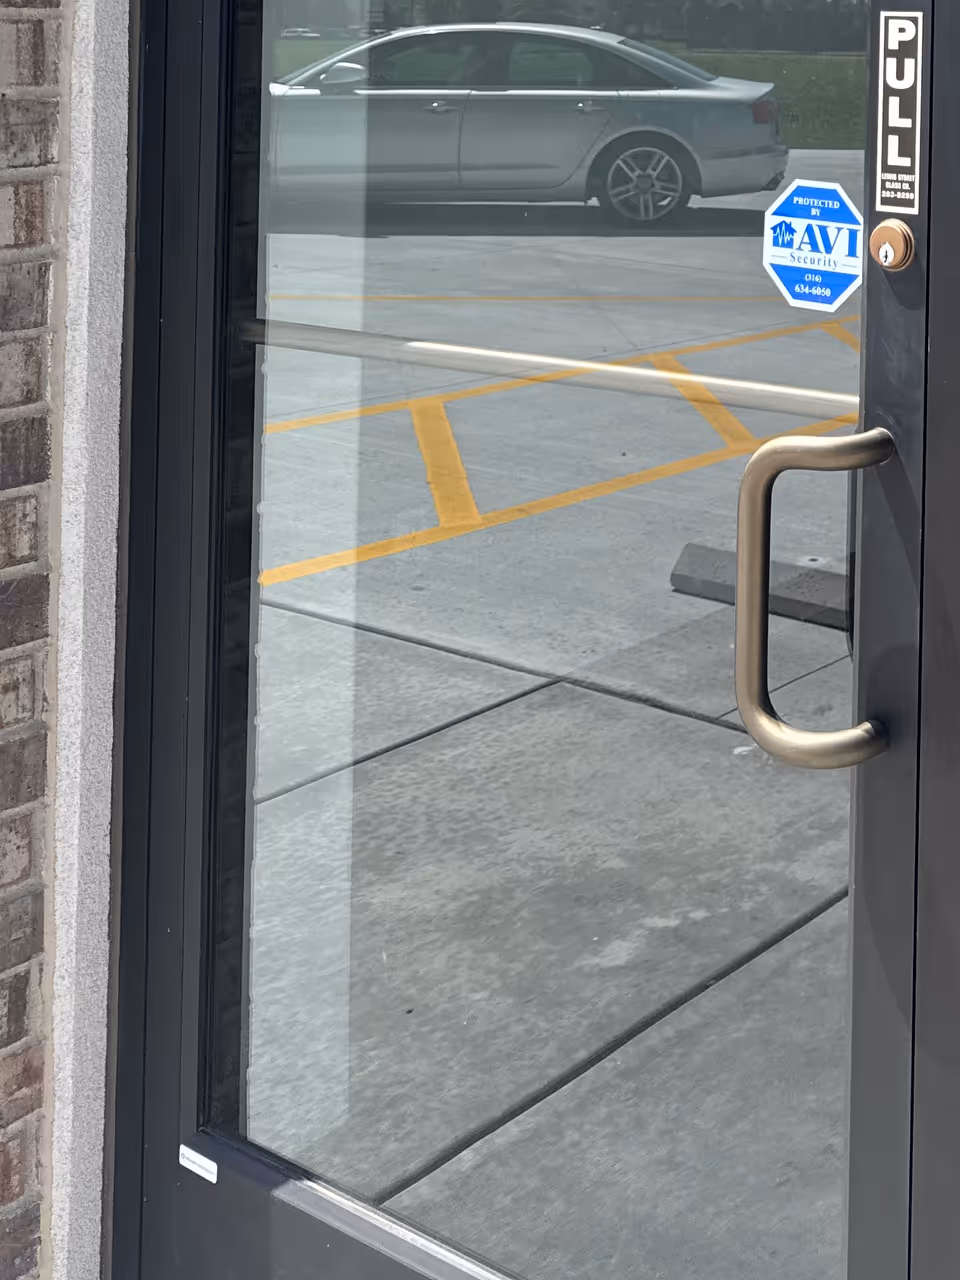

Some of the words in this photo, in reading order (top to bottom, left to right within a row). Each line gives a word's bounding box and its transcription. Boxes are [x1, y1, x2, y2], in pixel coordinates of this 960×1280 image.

[885, 19, 917, 167] PULL
[793, 196, 841, 209] PROTECTED
[811, 207, 822, 217] BY
[795, 223, 861, 259] AVI
[788, 251, 839, 270] Security
[804, 273, 822, 284] (316)
[794, 283, 832, 297] 634-6050
